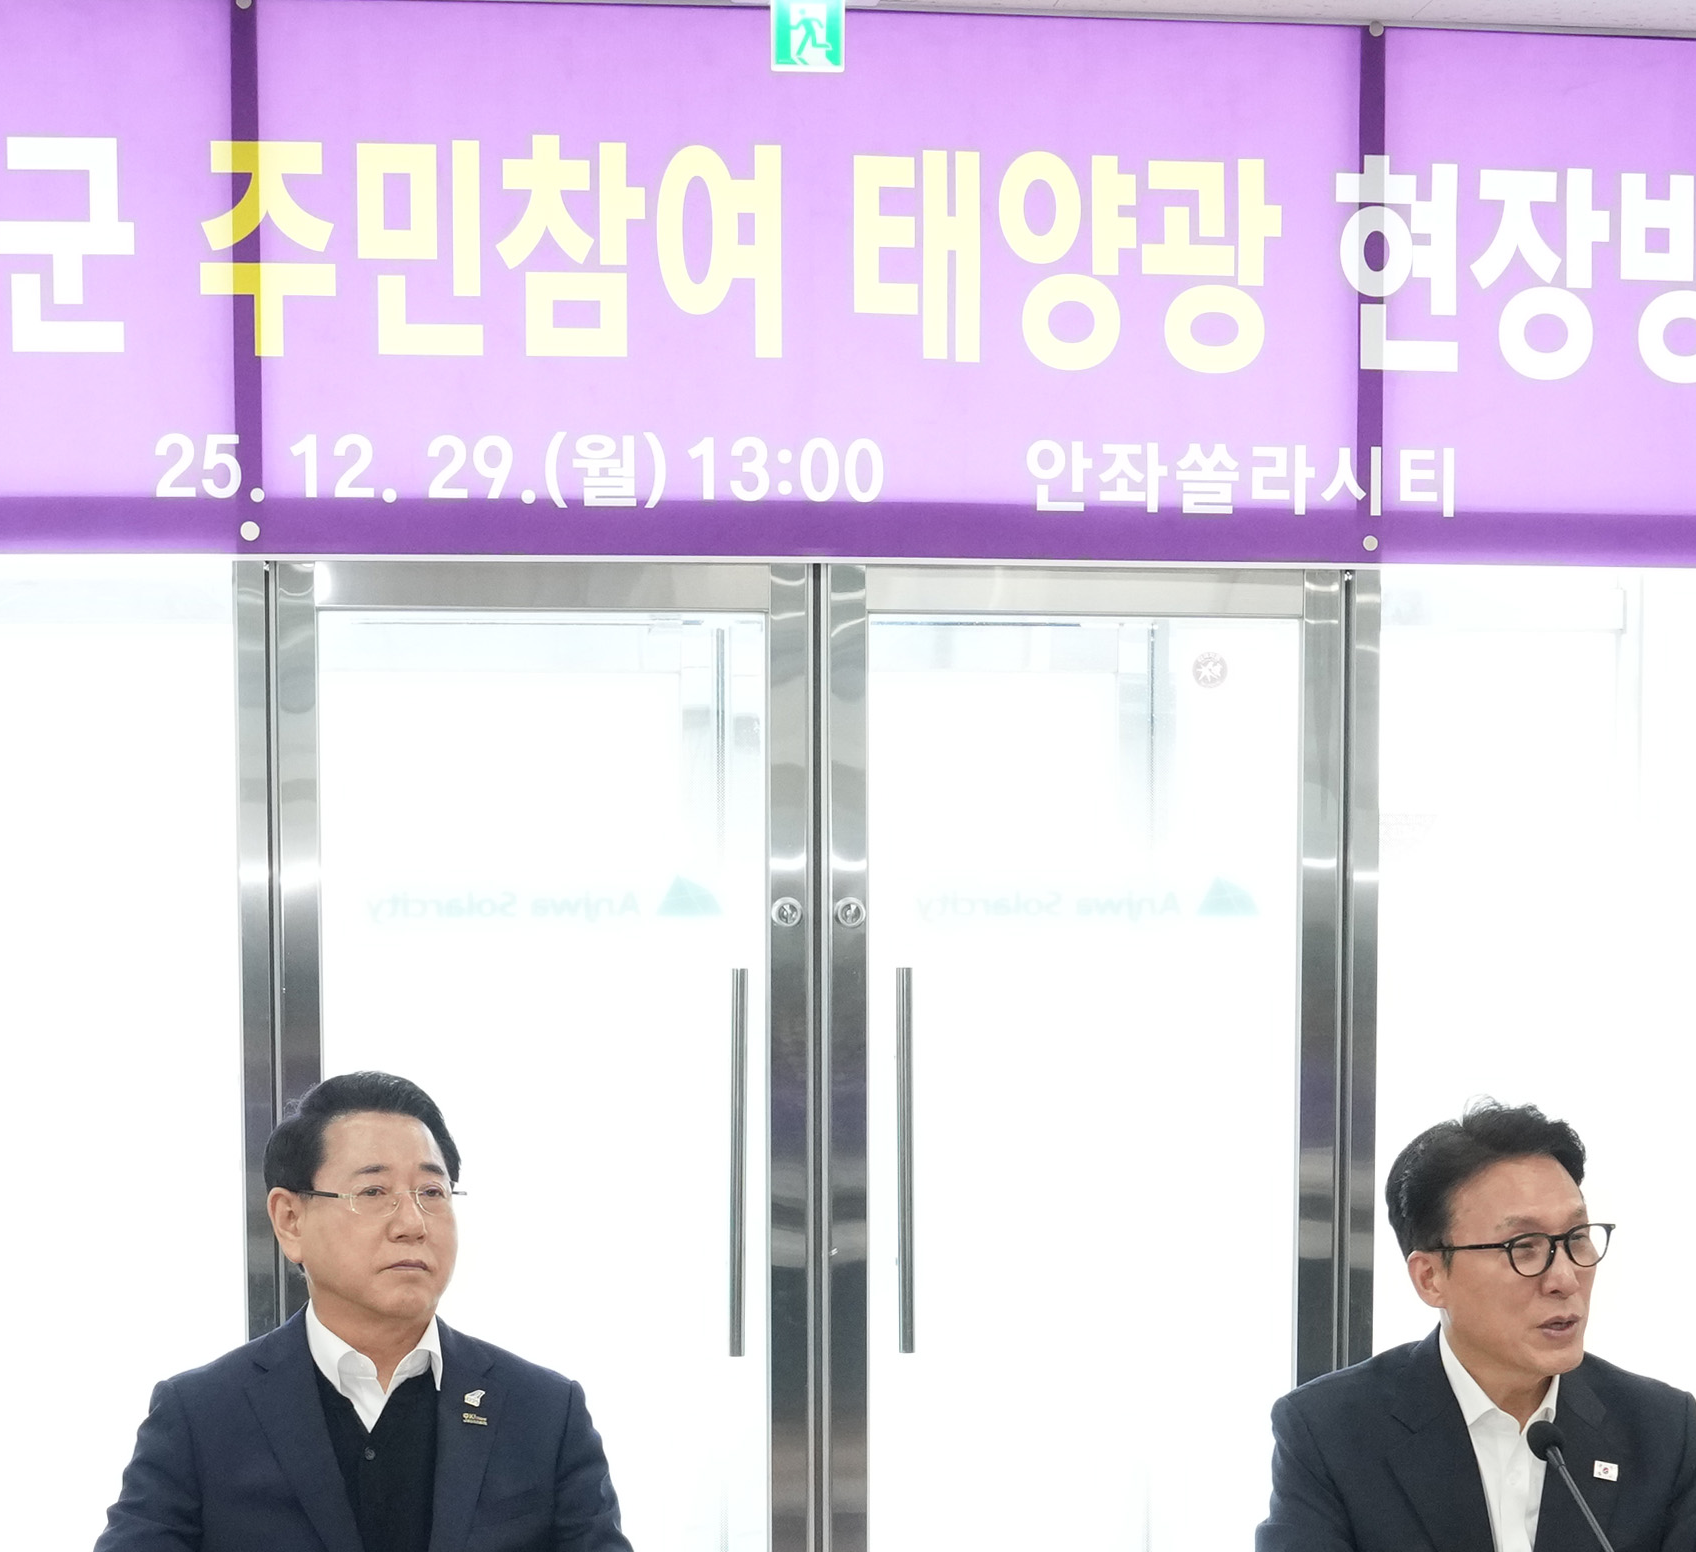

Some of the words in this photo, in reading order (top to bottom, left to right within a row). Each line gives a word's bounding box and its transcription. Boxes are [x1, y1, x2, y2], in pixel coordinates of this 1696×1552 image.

[199, 134, 783, 360] 주민참여
[852, 150, 1282, 374] 태양광
[153, 434, 265, 503] 25.
[290, 434, 398, 503] 12.
[688, 437, 884, 504] 13:00
[1026, 439, 1457, 518] 안좌쏠라시티
